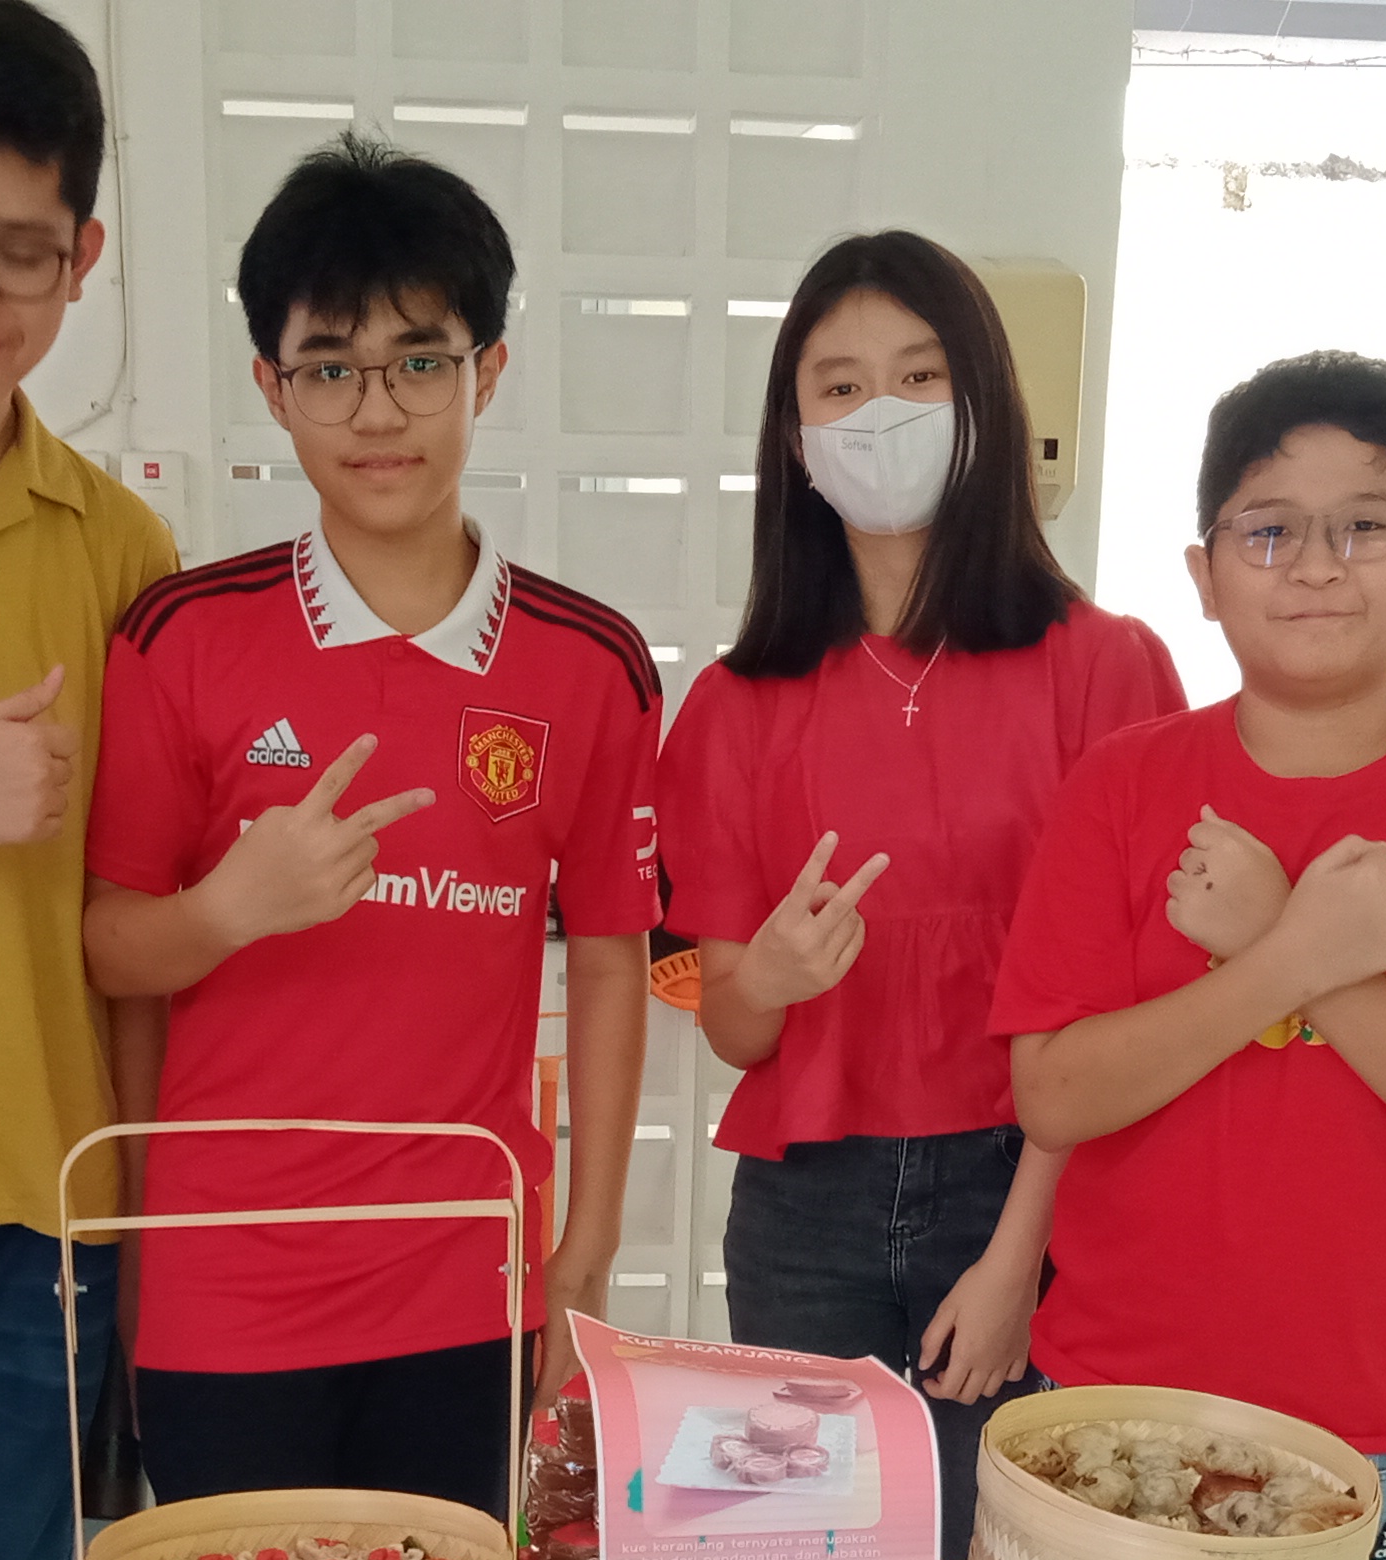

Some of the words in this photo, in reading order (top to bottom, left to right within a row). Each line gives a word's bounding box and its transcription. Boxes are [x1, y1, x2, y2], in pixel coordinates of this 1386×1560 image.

[246, 746, 311, 768] adidas
[474, 731, 530, 763] MANCHESTER
[481, 781, 519, 800] UNITED
[618, 1333, 664, 1347] KUE
[674, 1341, 810, 1364] KRANJANG
[622, 1543, 647, 1554] kue
[653, 1541, 724, 1553] keranjang
[732, 1537, 792, 1549] ternyata
[799, 1534, 877, 1546] merupakan
[795, 1550, 820, 1560] dan
[827, 1549, 881, 1560] jabatan
